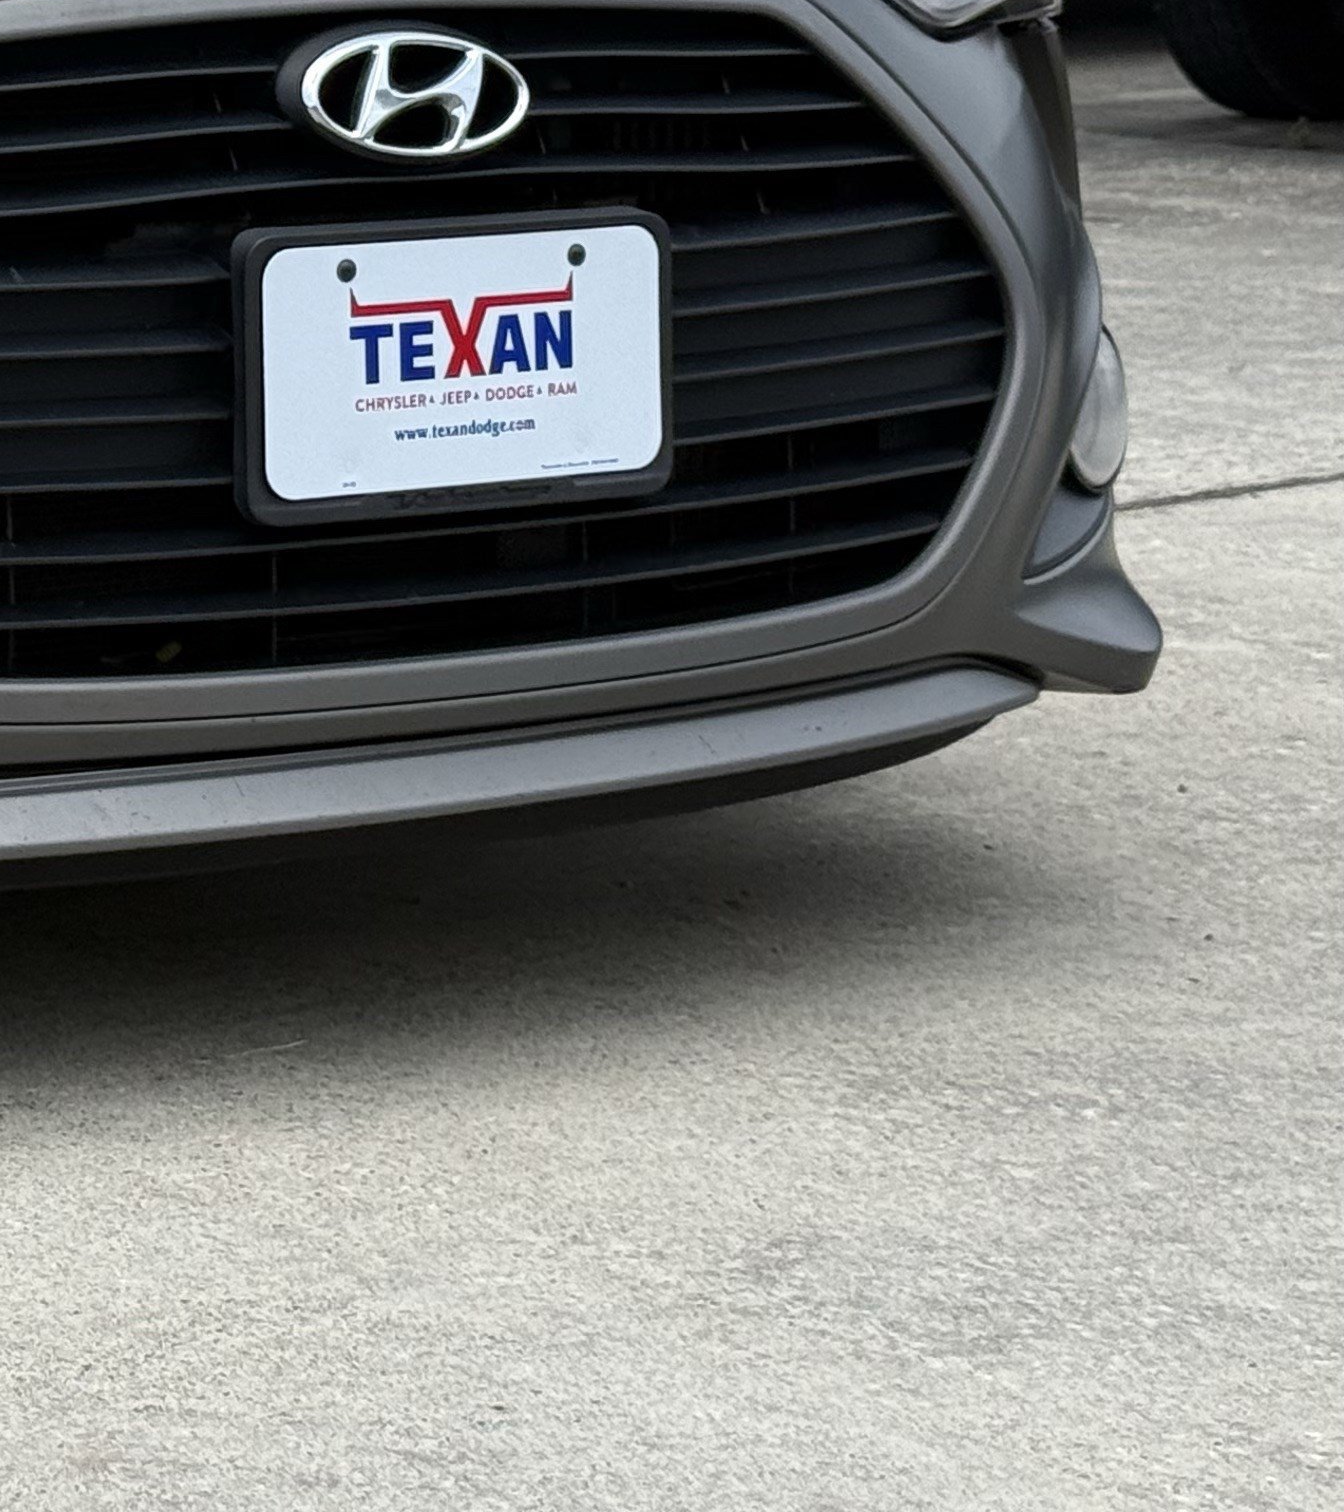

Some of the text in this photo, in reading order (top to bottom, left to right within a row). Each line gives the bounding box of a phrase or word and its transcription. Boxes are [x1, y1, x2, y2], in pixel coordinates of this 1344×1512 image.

[349, 284, 574, 385] TEXAN
[355, 381, 577, 412] CHRYSLER JEEP DODGE RAM
[394, 418, 536, 441] www.texandodge.com
